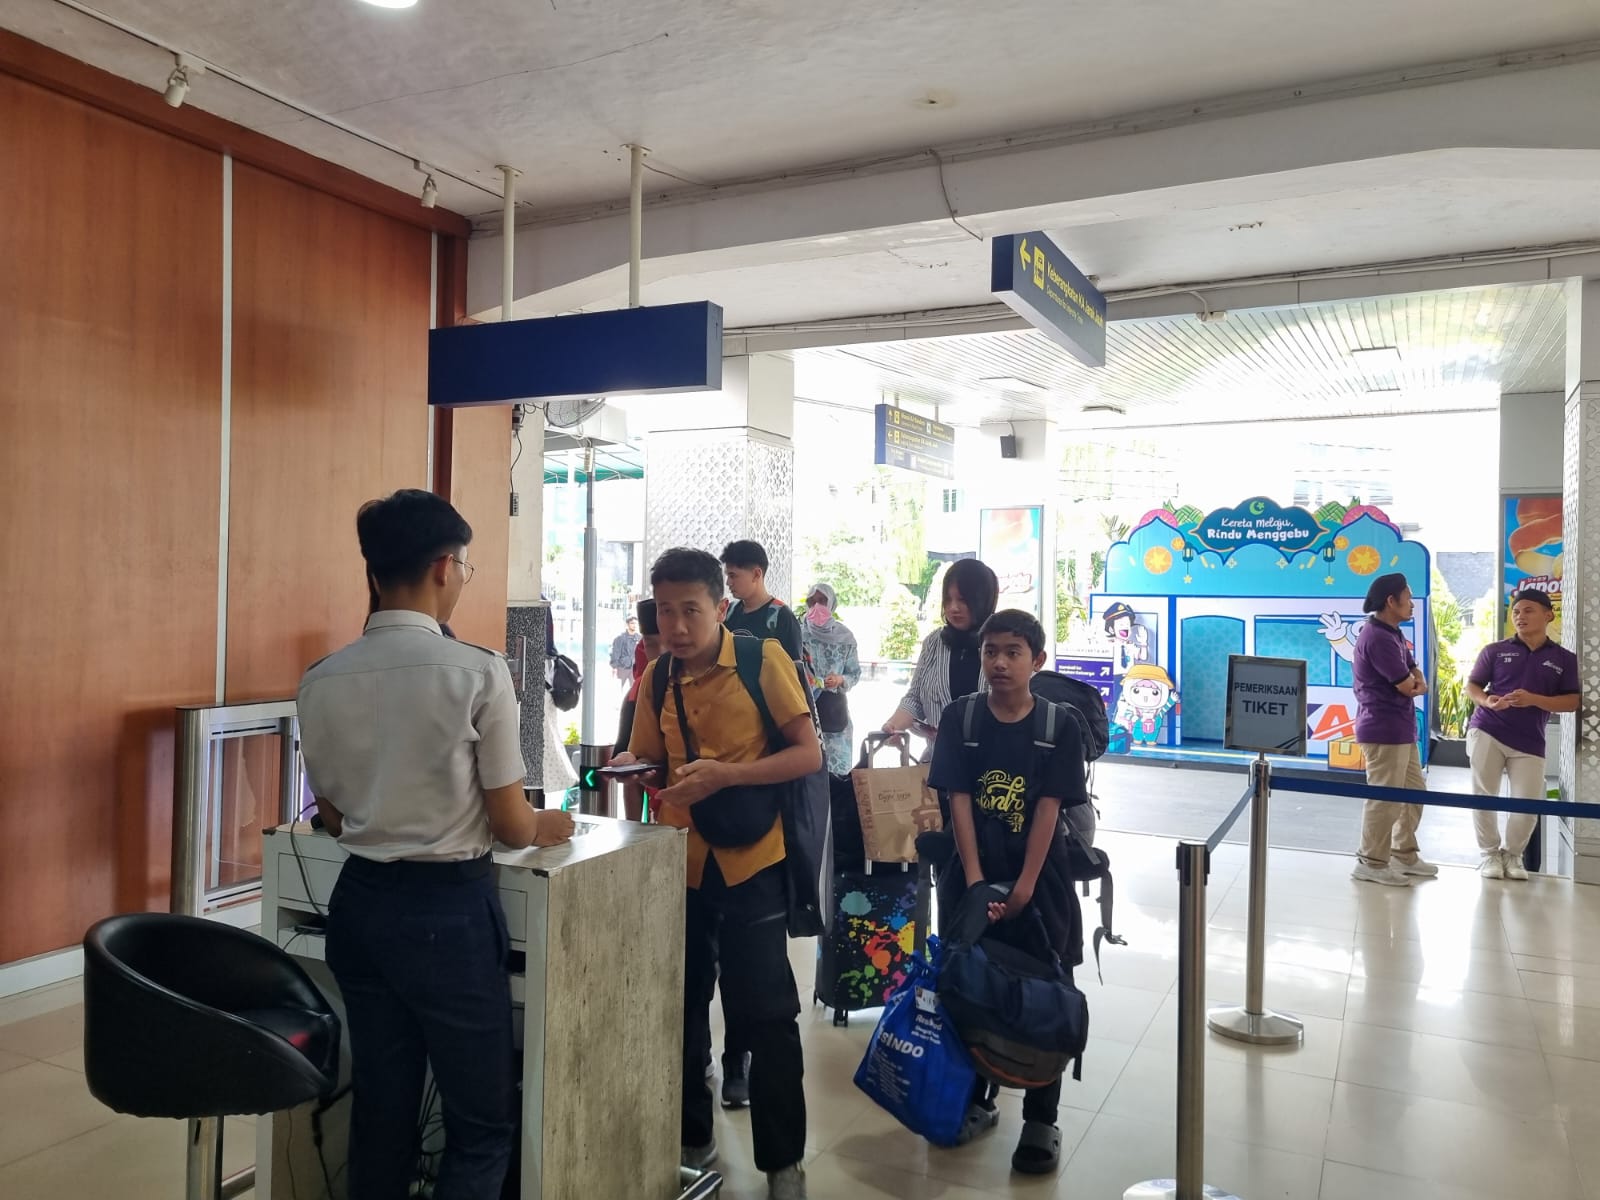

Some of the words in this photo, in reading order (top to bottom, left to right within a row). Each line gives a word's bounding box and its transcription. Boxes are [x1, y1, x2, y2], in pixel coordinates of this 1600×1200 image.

[1221, 517, 1252, 528] Kereta
[1207, 528, 1242, 539] Rindu
[1246, 529, 1309, 542] Menggebu
[1234, 682, 1298, 696] PEMERIKSAAN
[1242, 700, 1288, 716] TIKET
